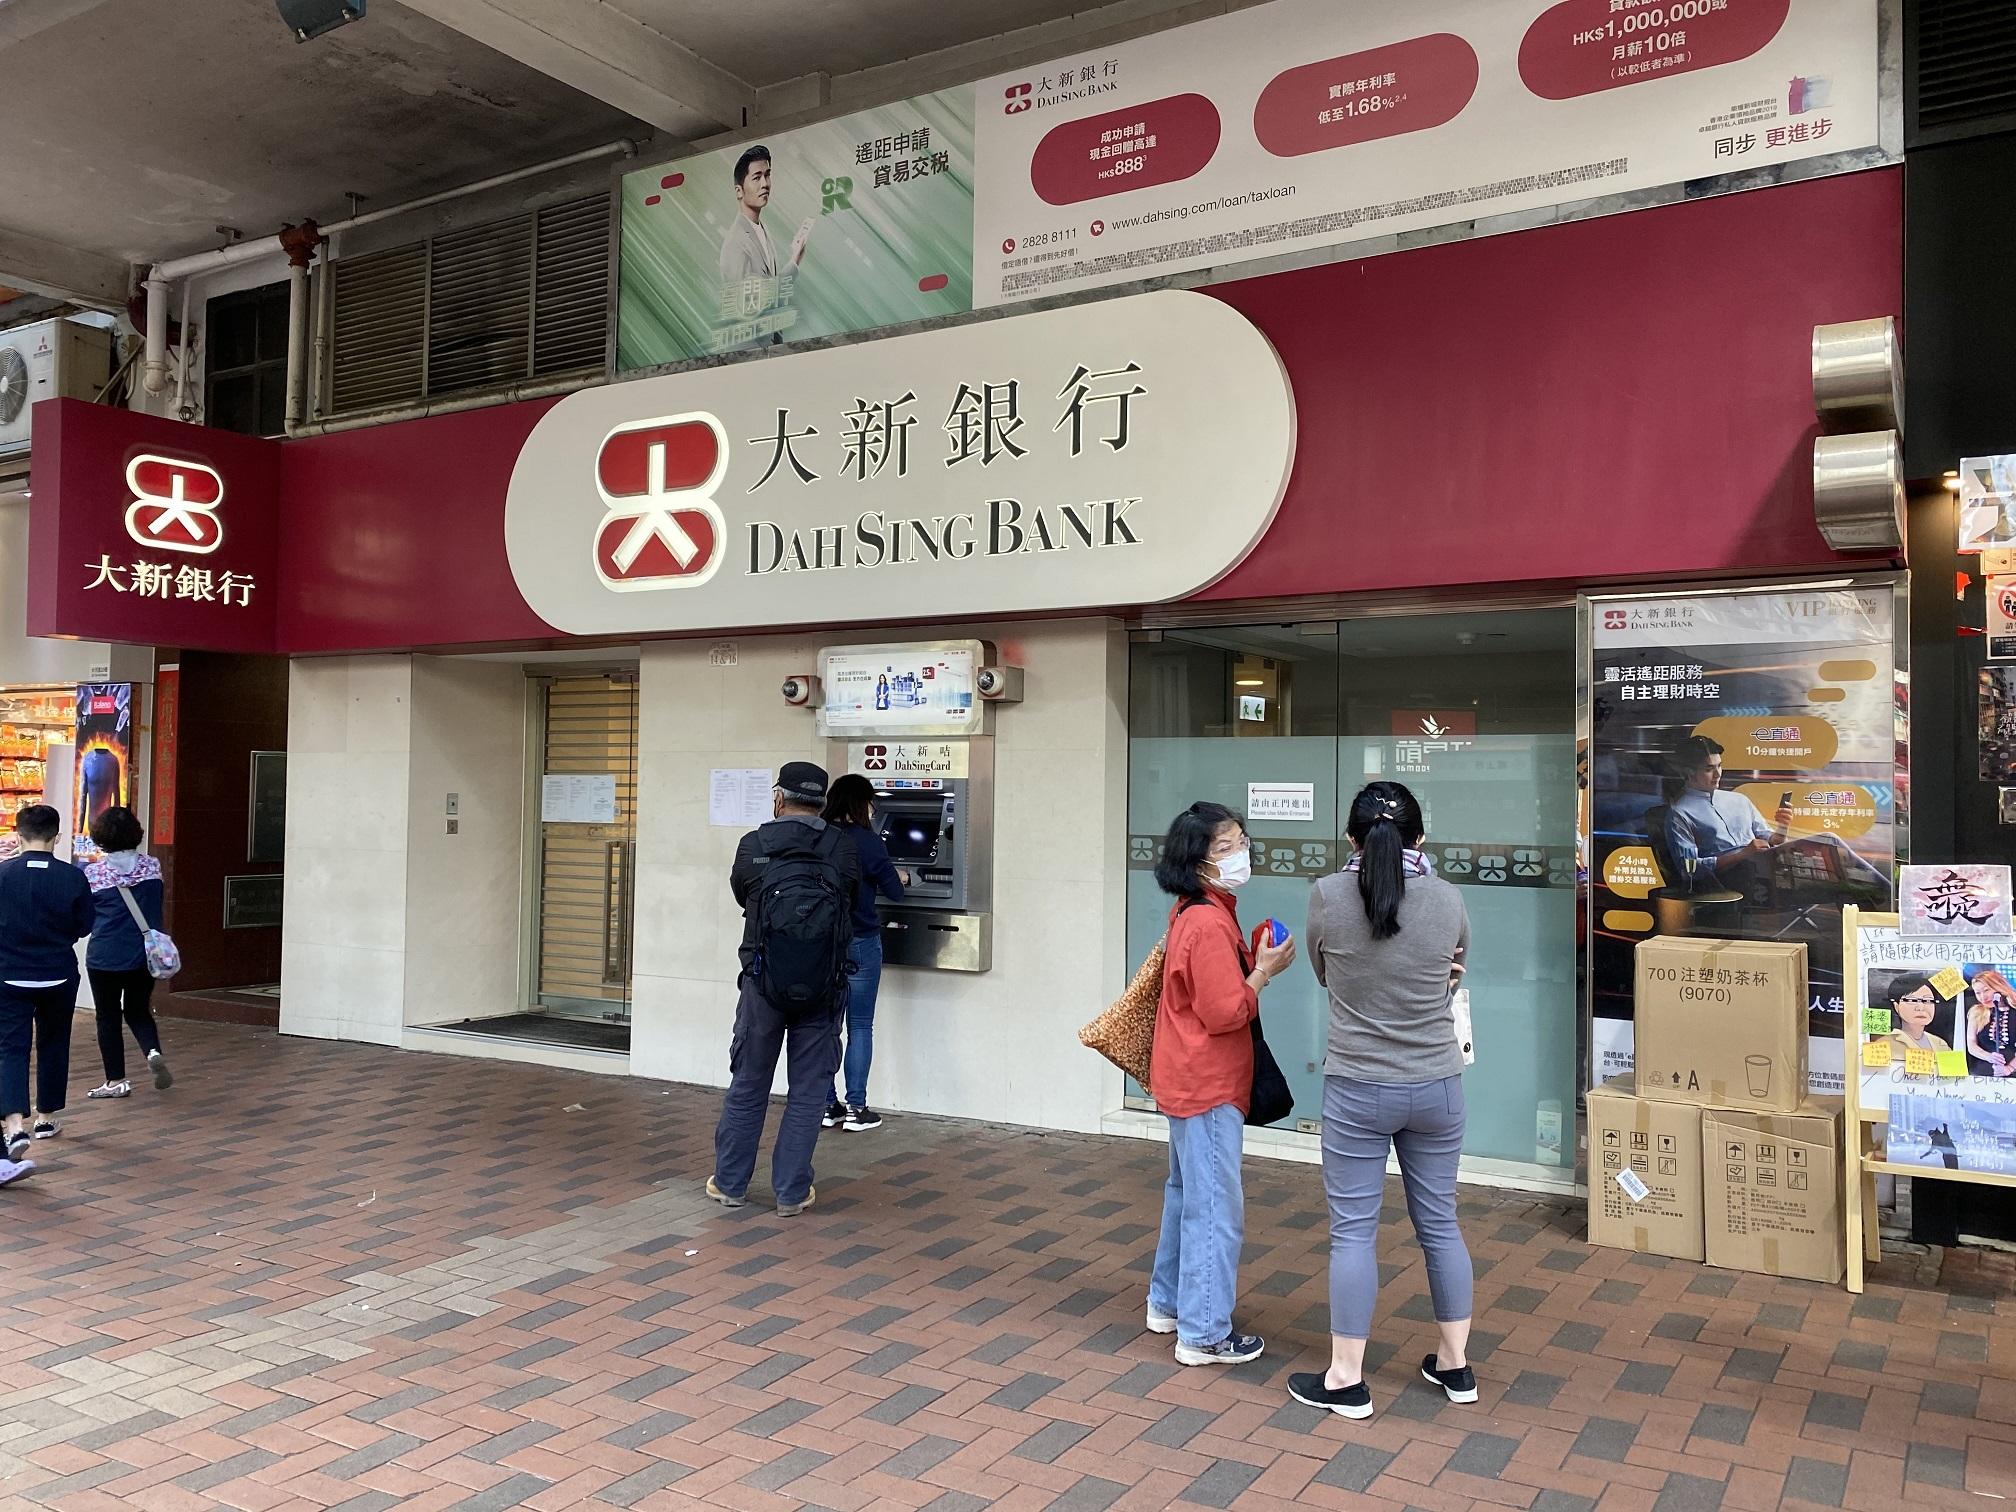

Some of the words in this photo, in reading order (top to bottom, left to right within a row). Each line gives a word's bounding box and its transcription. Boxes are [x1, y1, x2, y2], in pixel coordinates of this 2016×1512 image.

[1612, 31, 1686, 61] 月薪10倍
[1037, 59, 1119, 94] 大新銀行
[1329, 72, 1396, 99] 實際年利率
[1088, 81, 1118, 96] BANK
[1101, 122, 1146, 143] 成功申請
[1715, 134, 1756, 159] 同步
[1765, 118, 1833, 149] 更進步
[855, 127, 930, 165] 遙距申請
[1111, 184, 1297, 232] www.dahsing.com/loan/taxloan
[1022, 234, 1048, 249] 2828
[1051, 228, 1077, 243] 8111
[746, 360, 1148, 494] 大新銀行
[745, 520, 847, 576] DAH
[853, 511, 978, 568] SING
[983, 497, 1143, 556] BANK
[83, 554, 256, 607] 大新銀行
[1631, 606, 1696, 620] 大新銀行
[1784, 600, 1826, 617] VIP
[1604, 664, 1703, 682] 靈活遙距服務
[1621, 683, 1720, 700] 自主理財時空
[894, 760, 951, 774] DahSingCard
[1647, 967, 1677, 981] 700
[1681, 966, 1769, 987] 注塑奶茶杯
[1679, 986, 1732, 1005] (9070)
[1687, 1070, 1700, 1091] A
